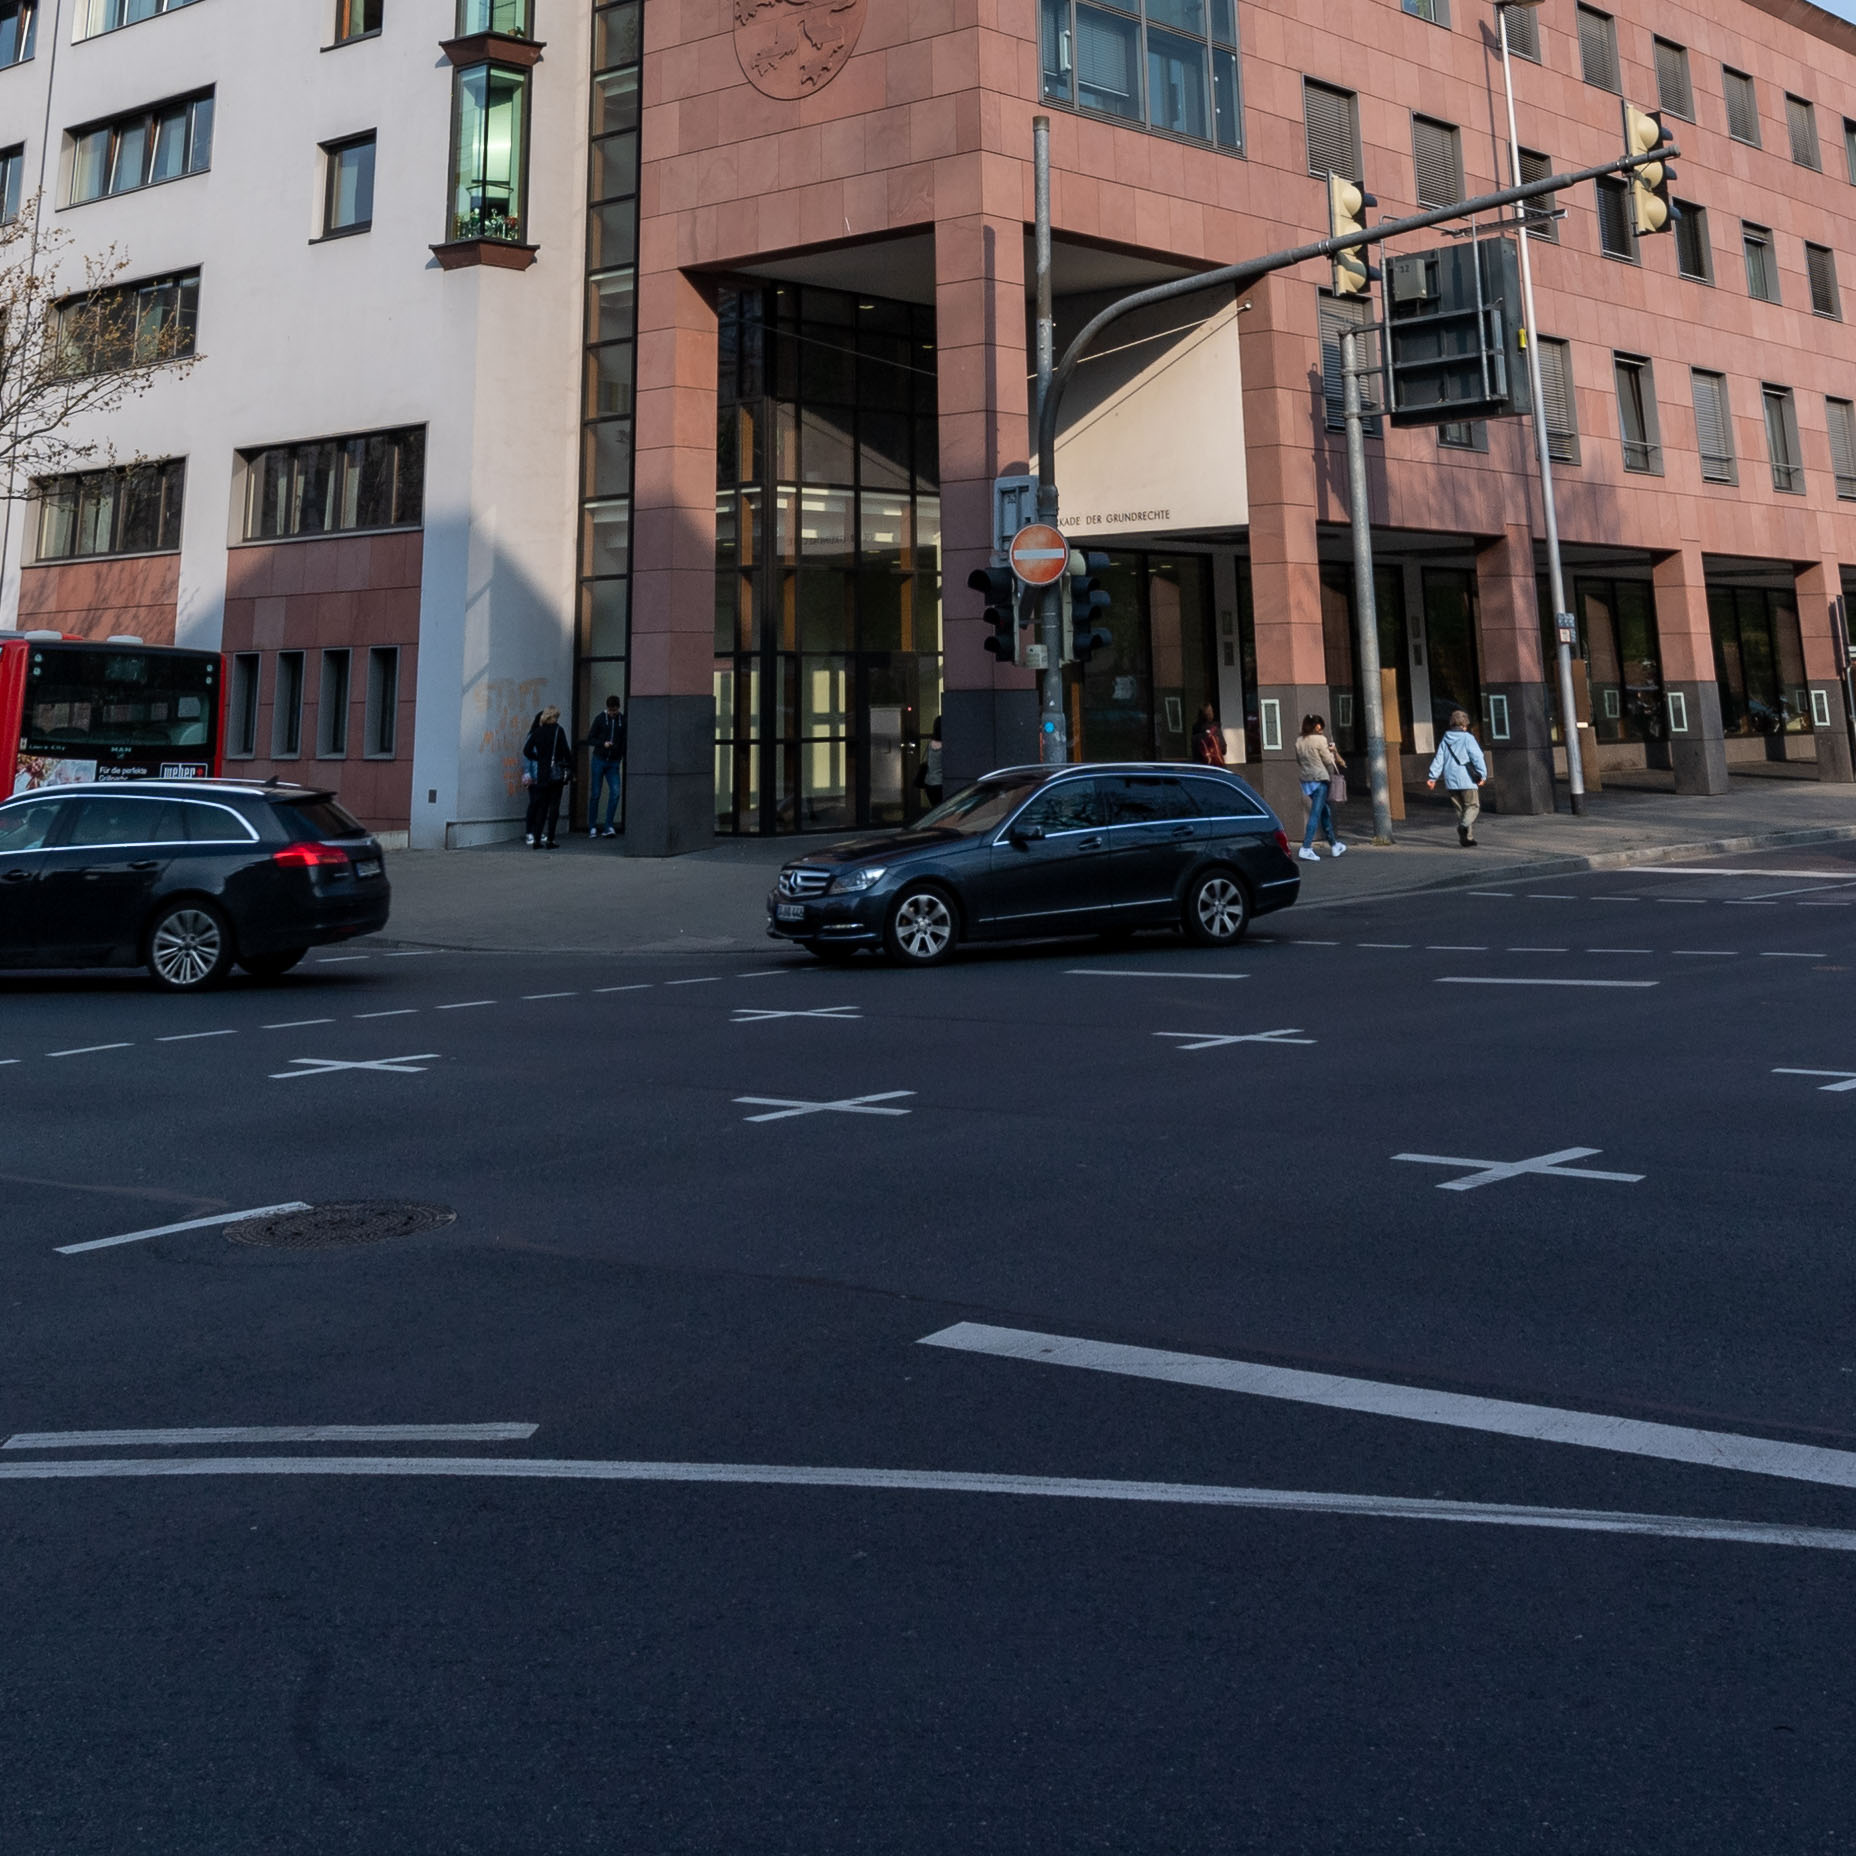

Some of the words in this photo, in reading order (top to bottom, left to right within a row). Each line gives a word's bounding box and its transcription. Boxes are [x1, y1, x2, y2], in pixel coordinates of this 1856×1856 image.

[1060, 516, 1081, 528] KADE
[1086, 514, 1102, 525] DER
[1106, 509, 1171, 524] GRUNDRECHTE
[99, 765, 109, 775] Für
[111, 766, 121, 775] die
[121, 766, 148, 777] perfekte
[163, 762, 197, 778] weber
